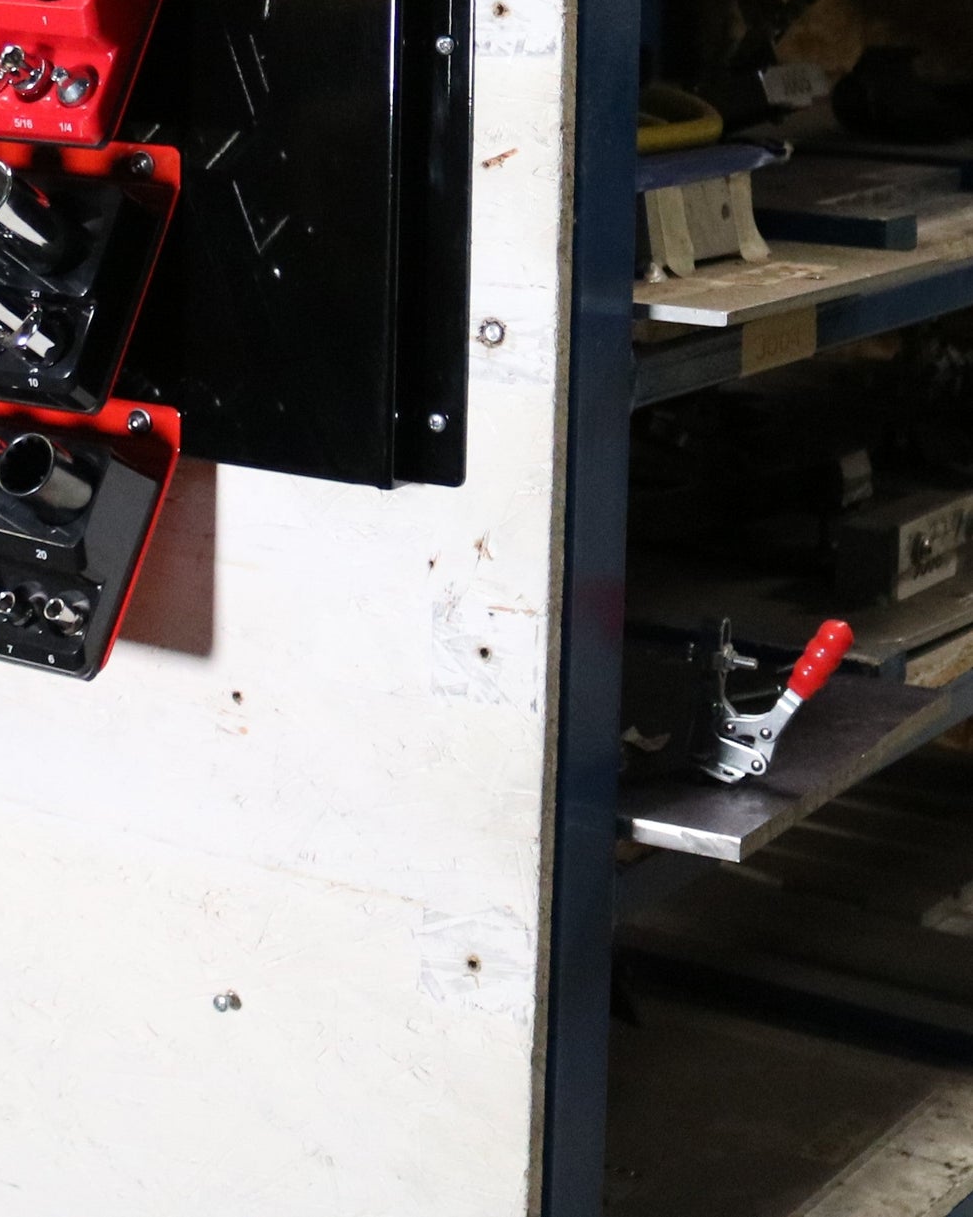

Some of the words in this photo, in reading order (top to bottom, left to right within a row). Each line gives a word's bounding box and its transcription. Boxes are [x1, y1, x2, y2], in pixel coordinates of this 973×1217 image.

[42, 16, 47, 25] 1
[14, 118, 33, 129] 5/16
[59, 122, 72, 132] 1/4
[28, 378, 38, 387] 10
[36, 549, 47, 560] 20
[7, 645, 13, 653] 7
[48, 655, 55, 664] 6
